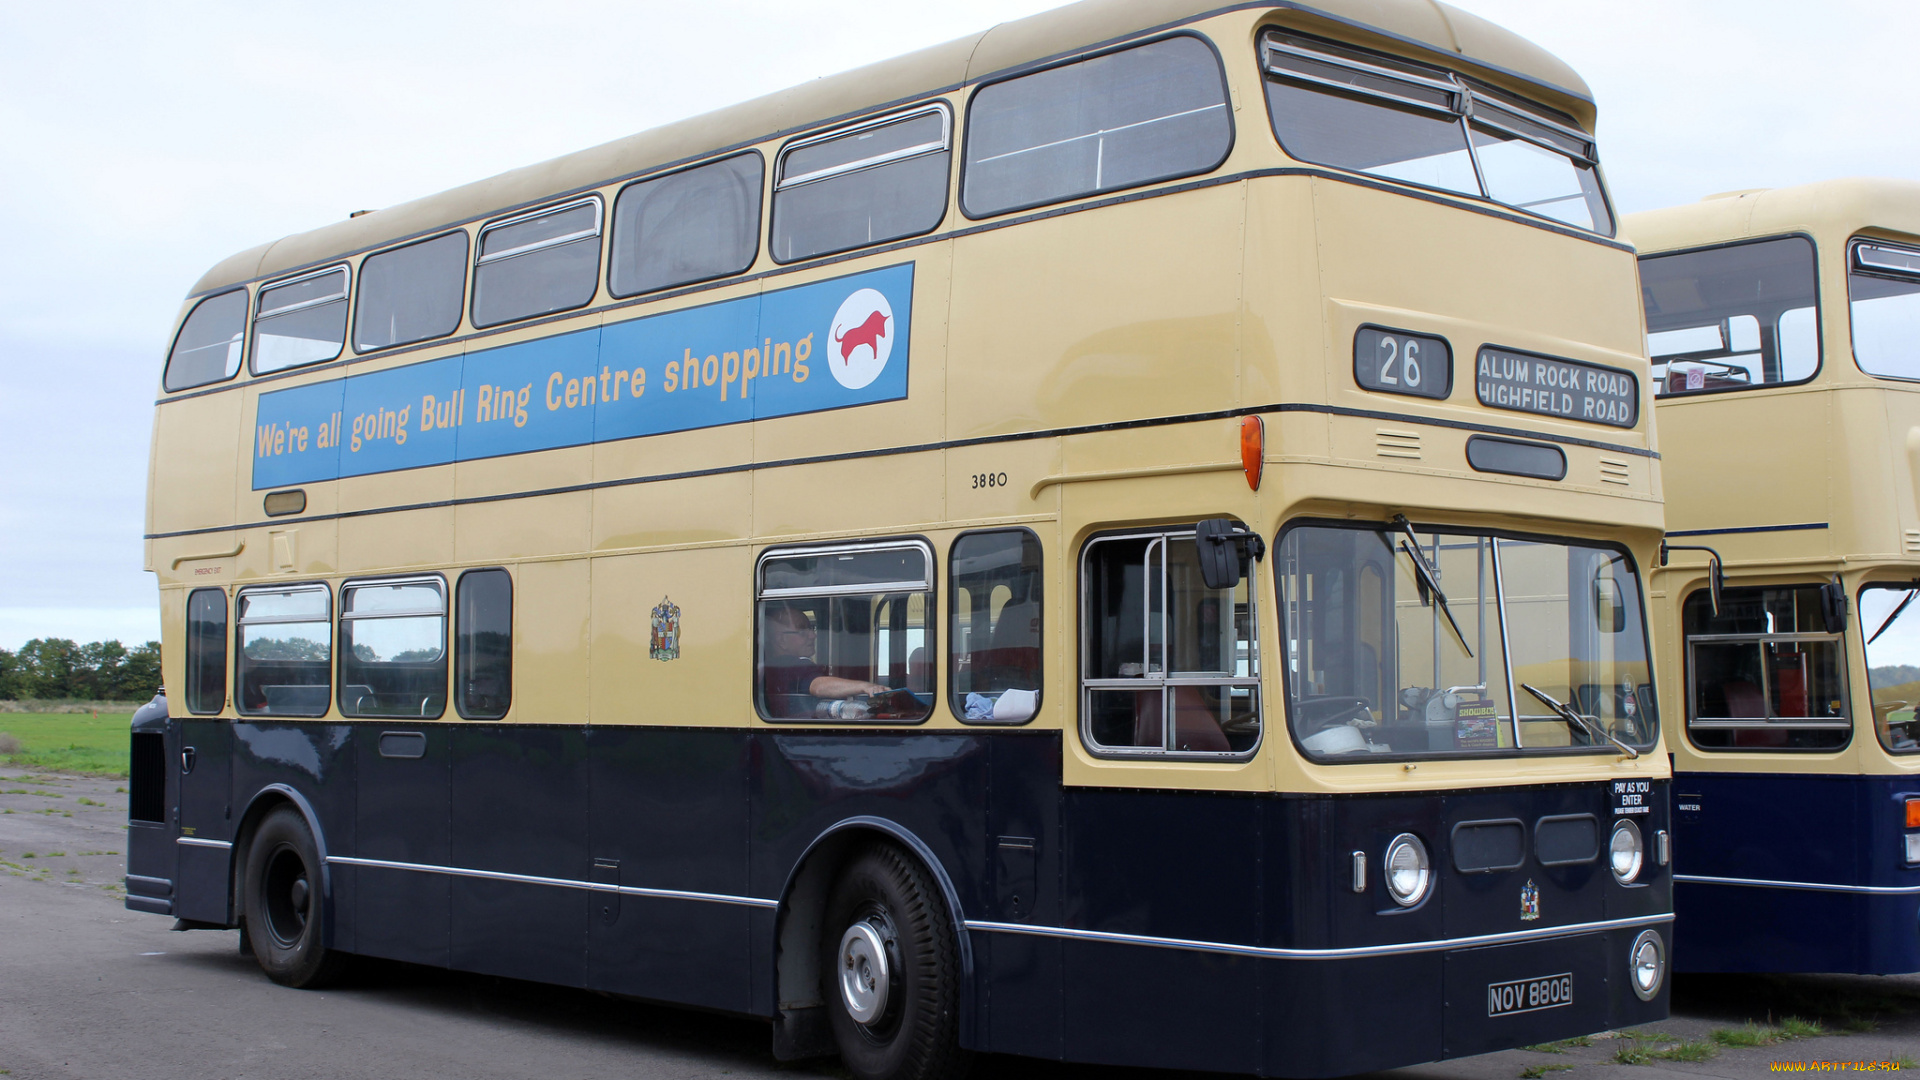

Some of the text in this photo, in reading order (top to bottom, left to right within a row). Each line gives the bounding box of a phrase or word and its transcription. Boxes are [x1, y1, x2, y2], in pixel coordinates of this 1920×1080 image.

[1380, 336, 1421, 387] 26
[1478, 354, 1629, 397] ALUM ROCK ROAD
[257, 332, 814, 458] We're all going Bull Ring Centre shopping
[1478, 382, 1629, 423] HIGHFIELD ROAD
[972, 472, 1008, 489] 3880
[1614, 782, 1649, 794] PAY AS YOU
[1622, 794, 1643, 806] ENTER
[1490, 978, 1570, 1012] NOV 880G
